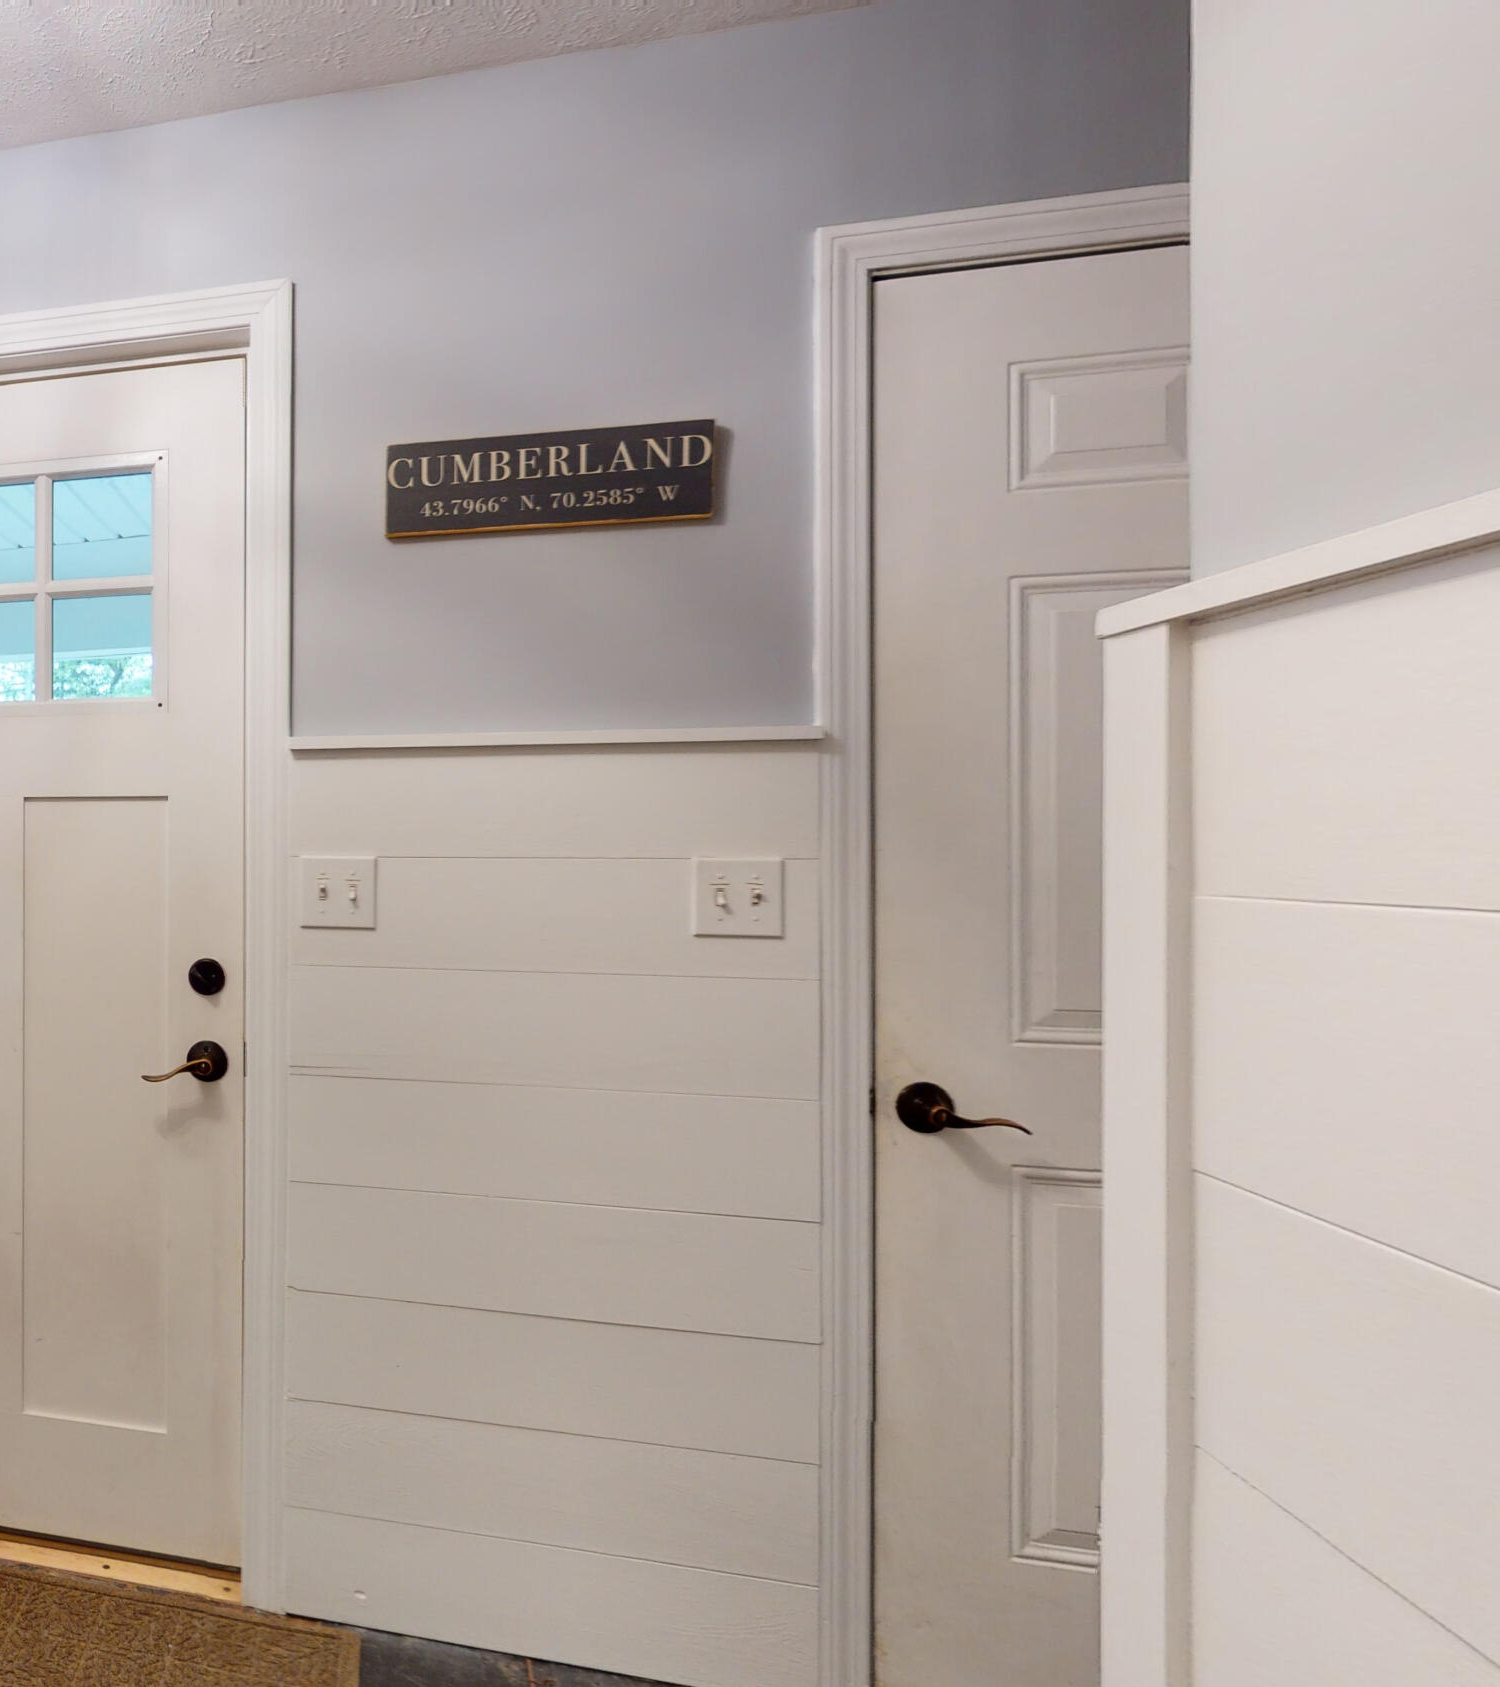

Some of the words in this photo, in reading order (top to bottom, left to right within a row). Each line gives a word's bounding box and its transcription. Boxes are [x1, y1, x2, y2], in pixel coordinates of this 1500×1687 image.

[387, 434, 713, 490] CUMBERLAND
[419, 496, 508, 517] 43.7966°
[550, 487, 645, 509] 70.2585°
[657, 484, 680, 502] W
